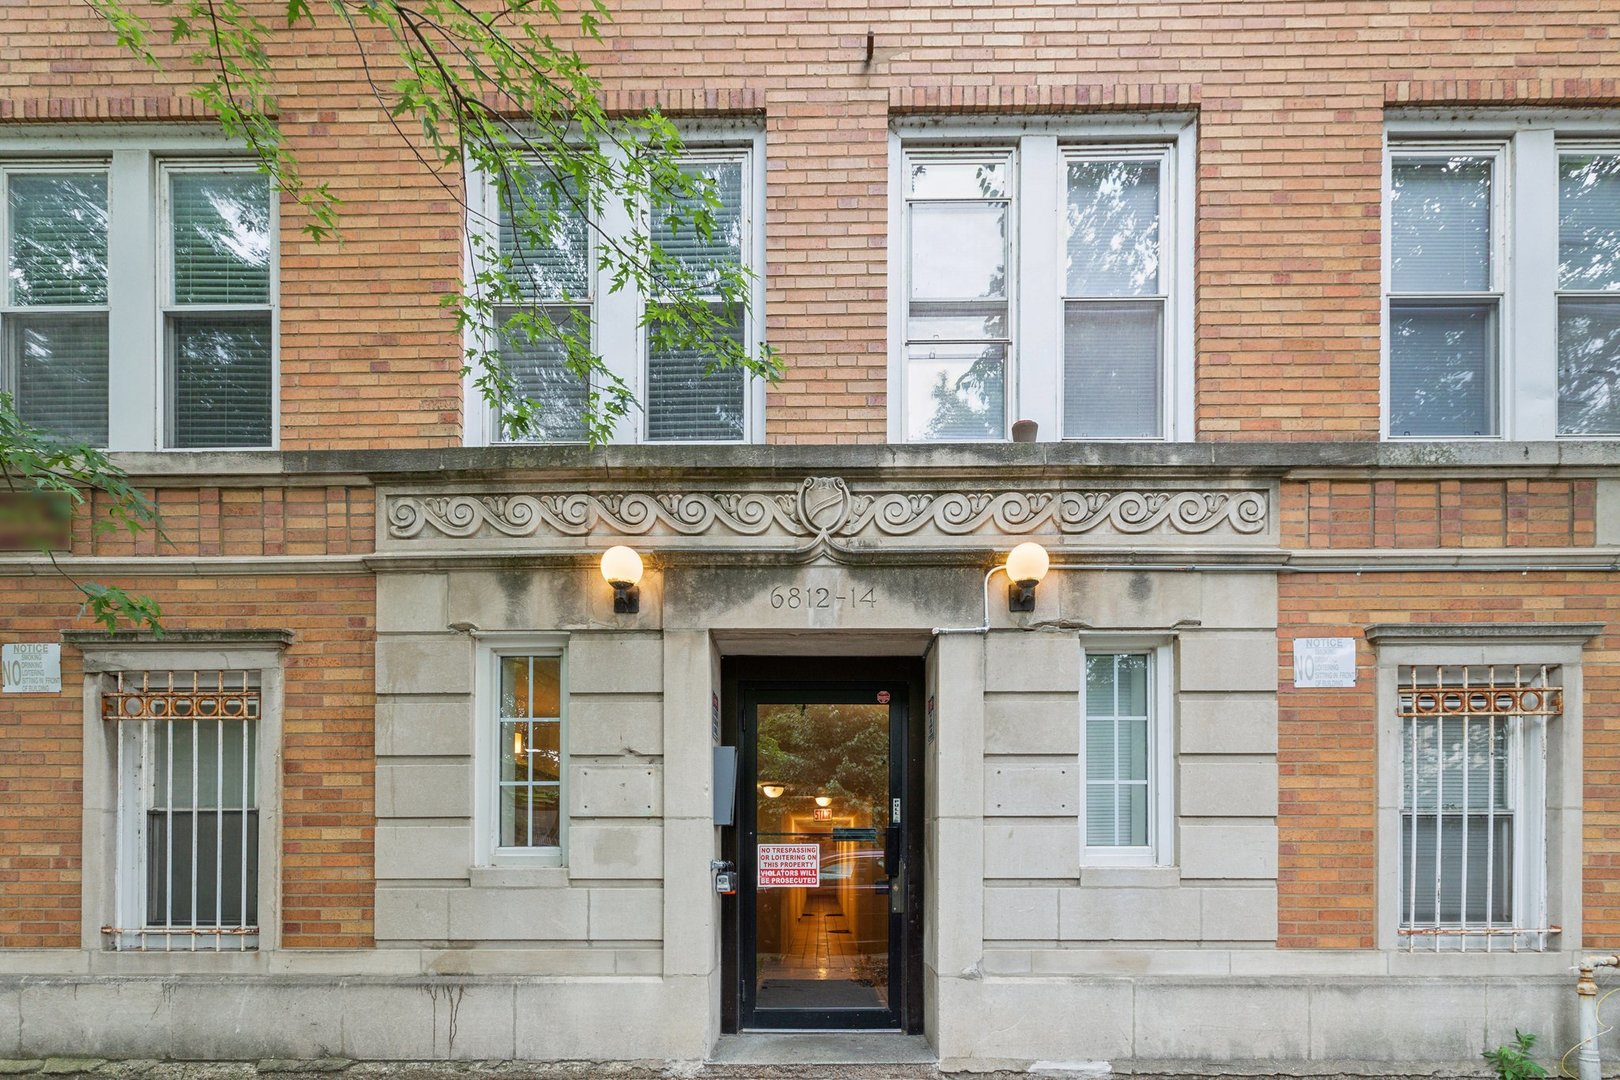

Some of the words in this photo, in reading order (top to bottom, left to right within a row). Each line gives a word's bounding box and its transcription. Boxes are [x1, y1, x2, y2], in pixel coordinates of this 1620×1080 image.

[770, 585, 877, 609] 6812-14
[13, 644, 48, 654] NOTICE
[1305, 638, 1344, 648] NOTICE
[2, 660, 21, 686] NO
[1294, 654, 1315, 681] NO
